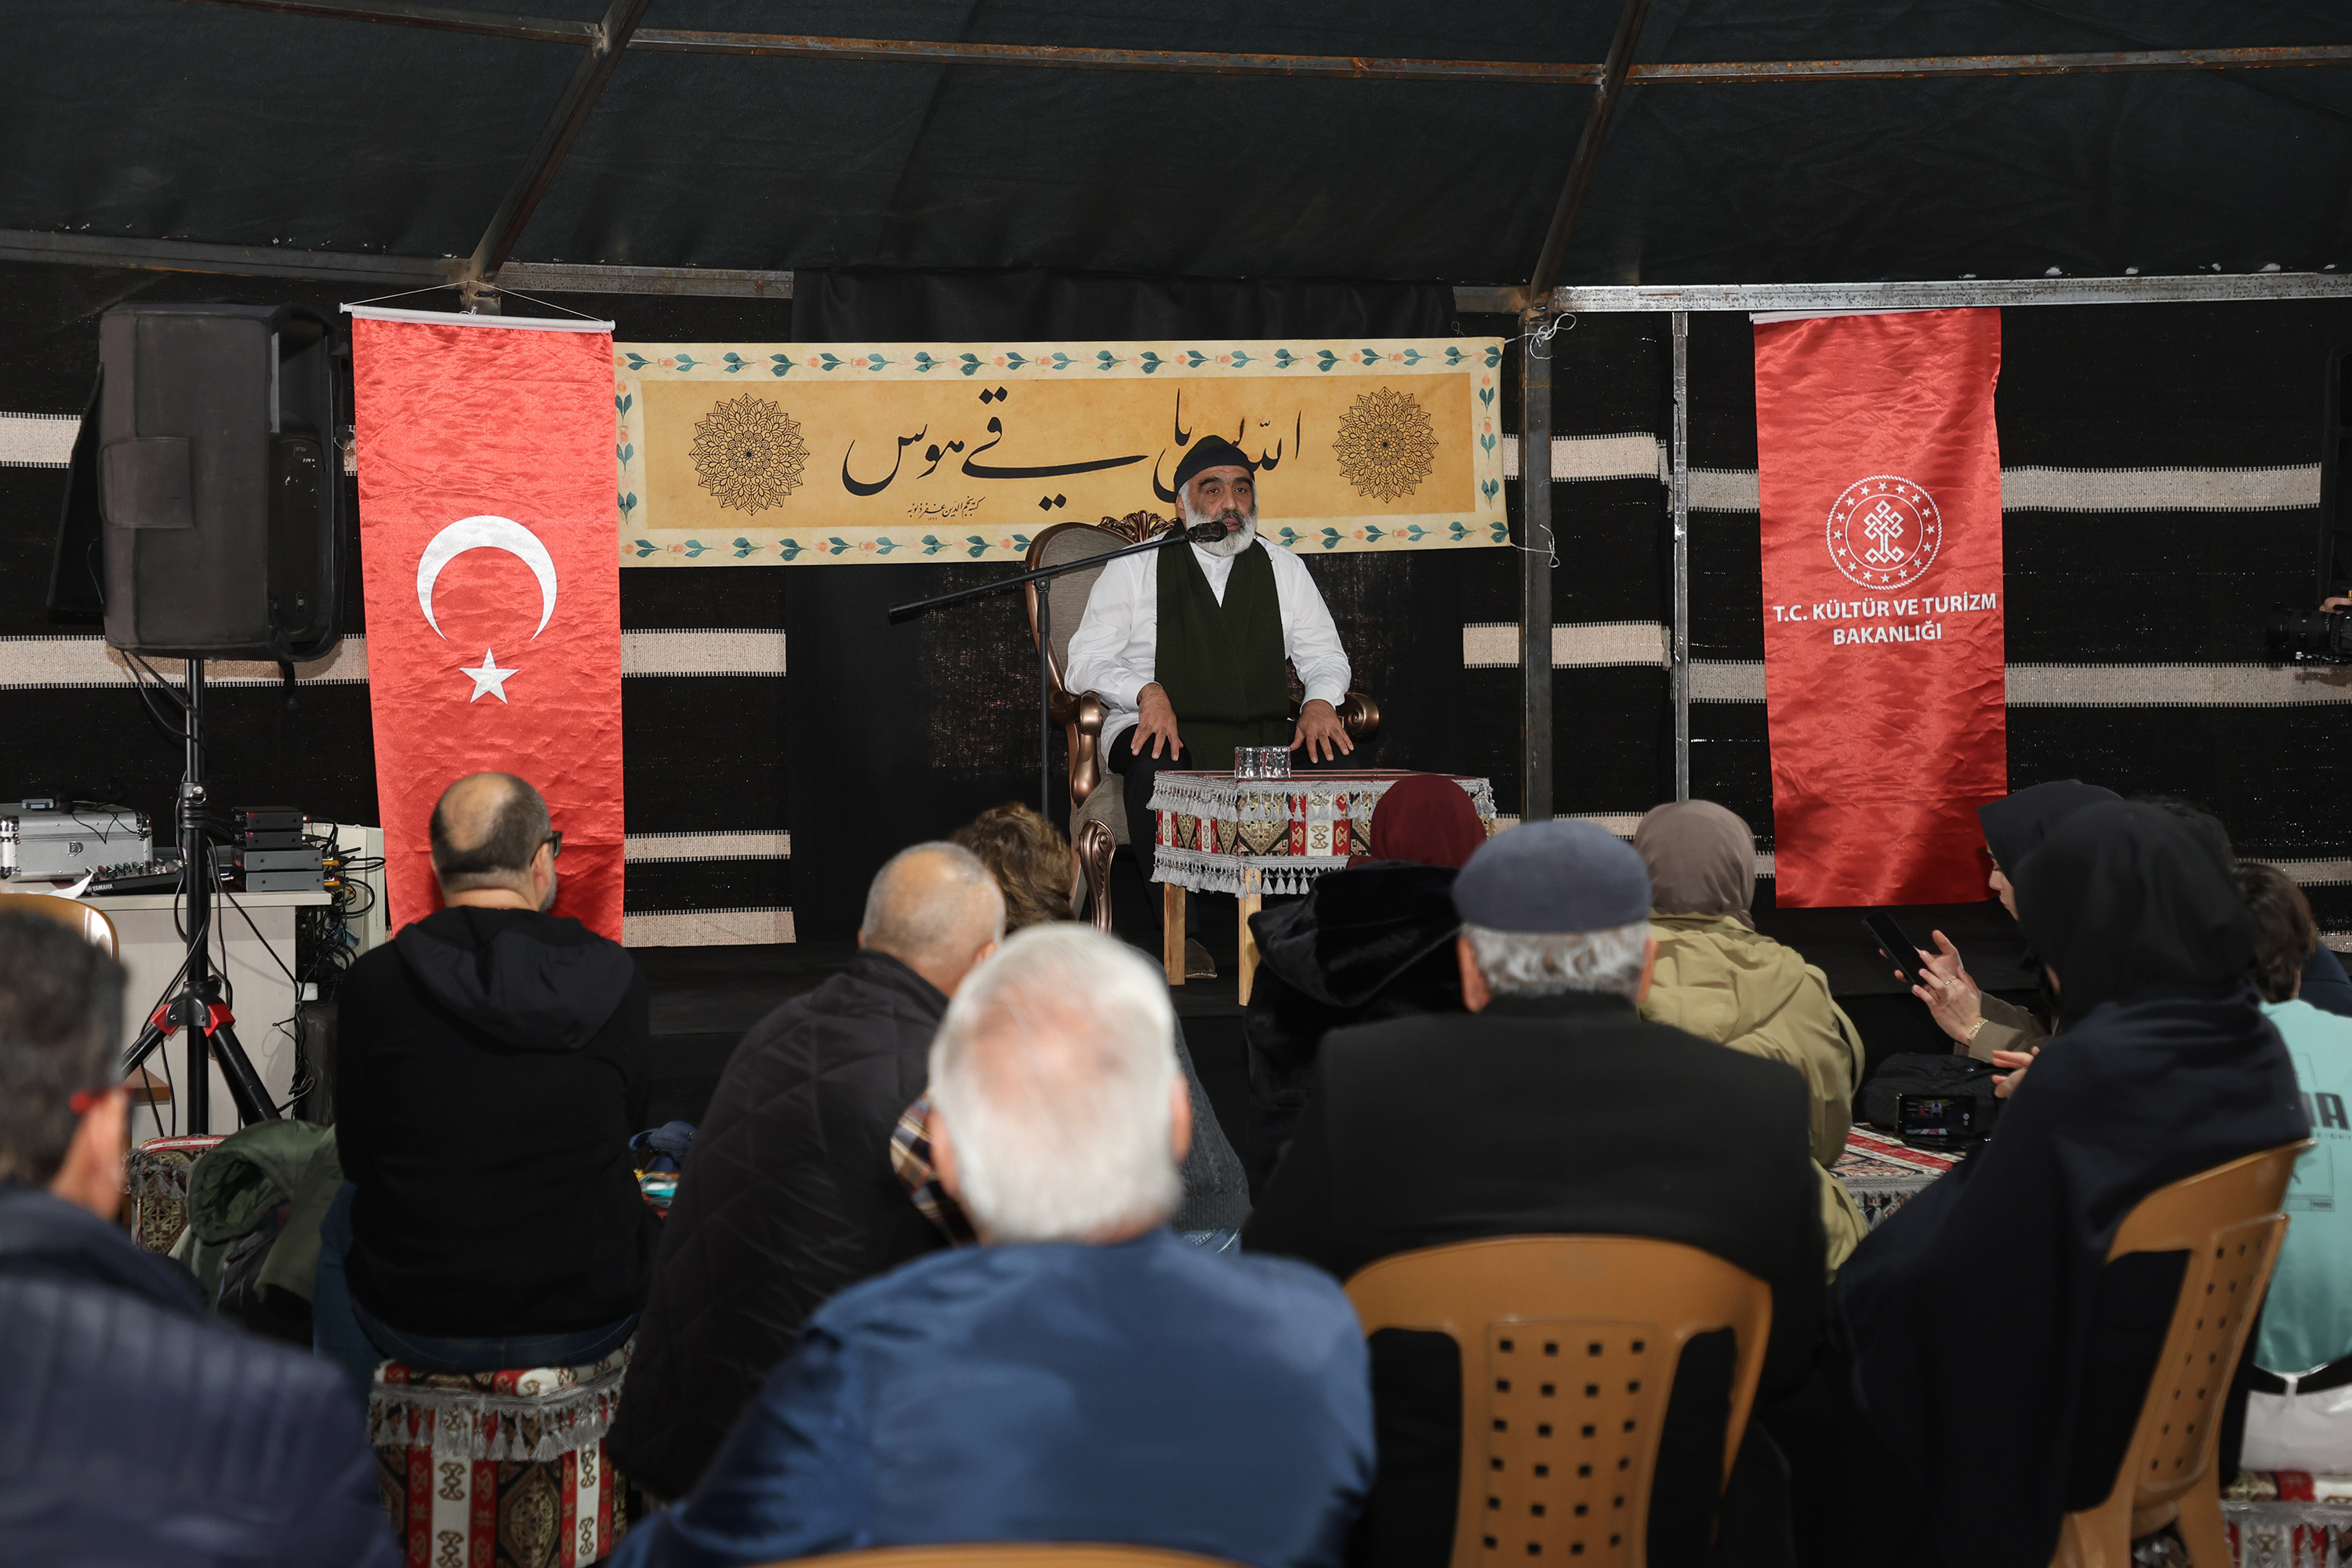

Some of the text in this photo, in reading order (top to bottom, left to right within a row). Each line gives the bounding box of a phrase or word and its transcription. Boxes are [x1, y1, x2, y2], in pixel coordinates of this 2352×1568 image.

[1772, 590, 1996, 622] T.C. KÜLTÜR VE TURİZM
[1833, 619, 1942, 645] BAKANLIĞI
